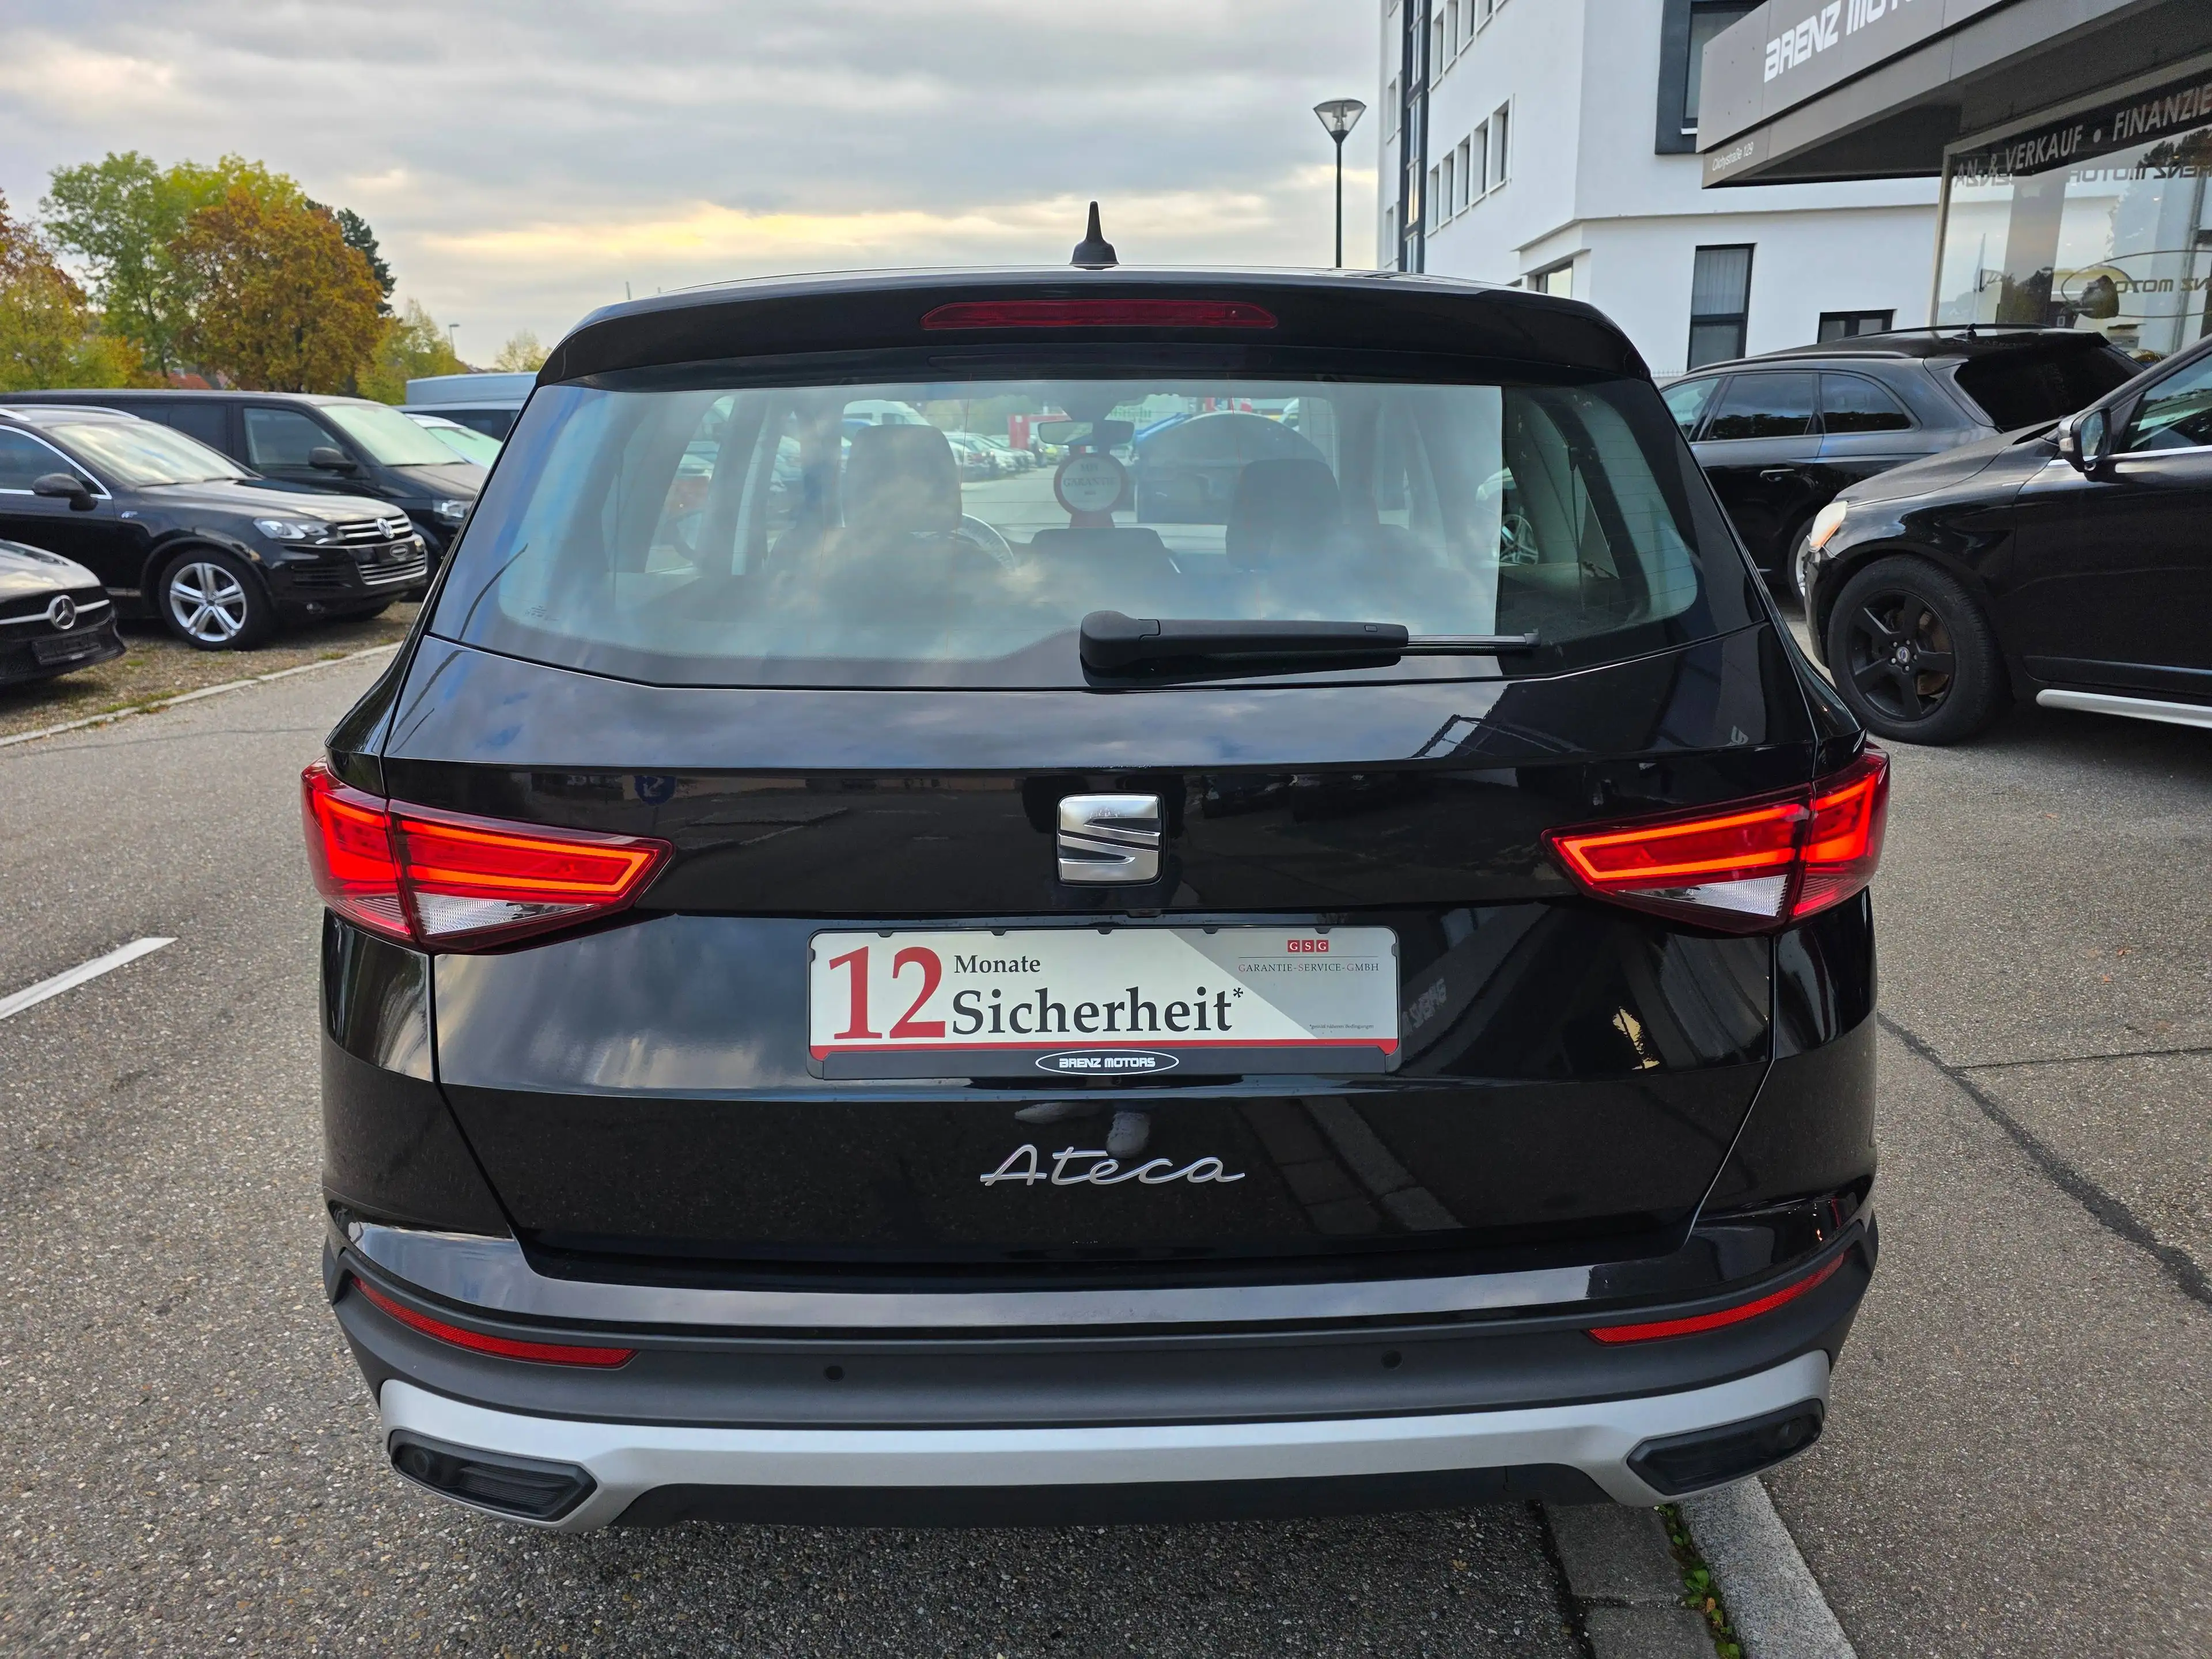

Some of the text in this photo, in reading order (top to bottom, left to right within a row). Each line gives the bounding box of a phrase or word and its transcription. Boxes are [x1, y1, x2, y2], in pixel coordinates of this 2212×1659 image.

[1764, 0, 1841, 83] BRENZ
[2006, 125, 2084, 173] VERKAUF
[829, 946, 1041, 1040] 12 Monate
[1059, 1058, 1156, 1068] BRENZ MOTORS
[980, 1143, 1245, 1186] Ateca
